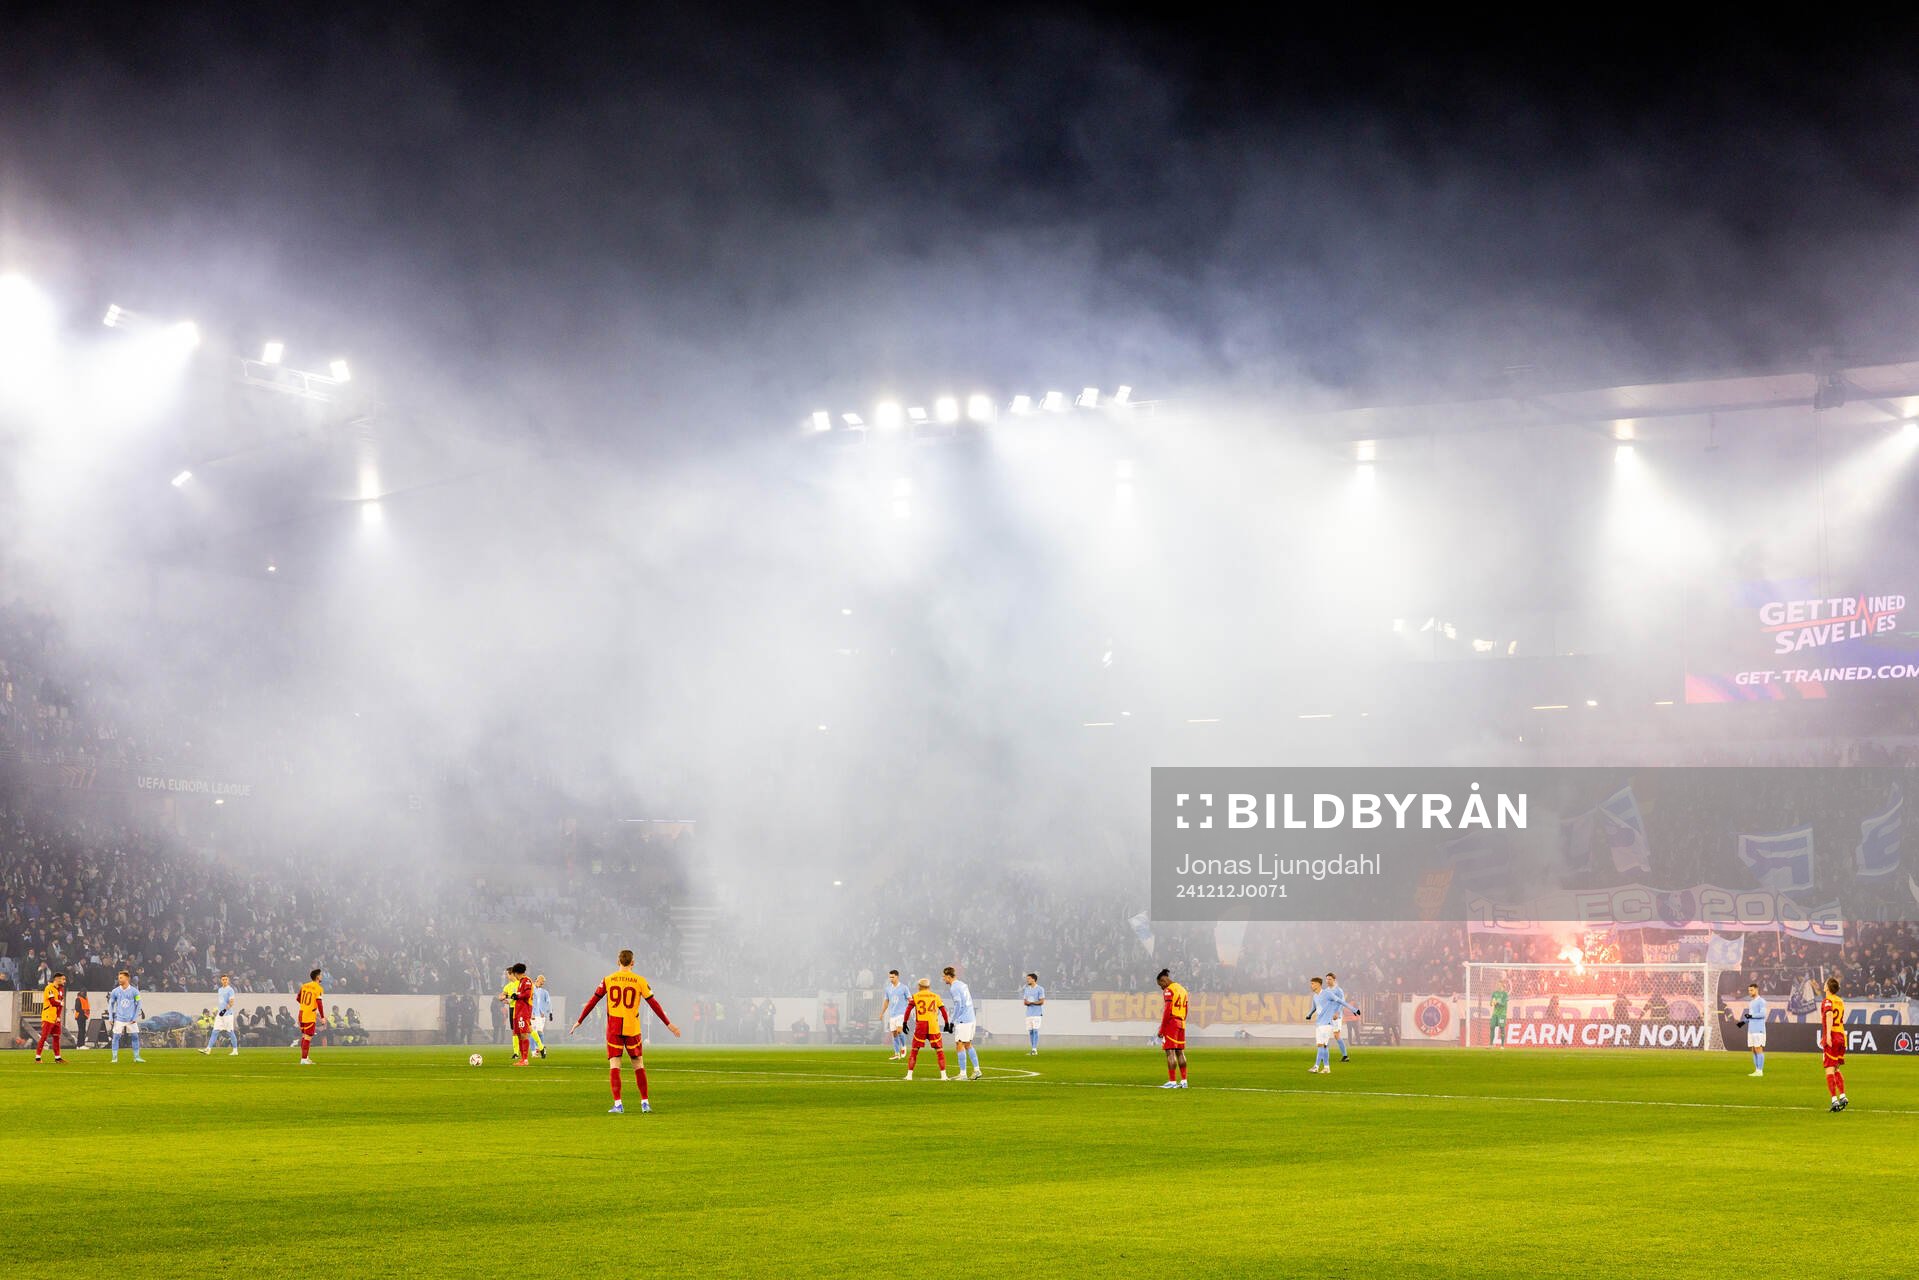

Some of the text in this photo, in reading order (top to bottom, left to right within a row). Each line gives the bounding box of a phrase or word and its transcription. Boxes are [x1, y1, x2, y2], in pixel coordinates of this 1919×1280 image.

[1759, 599, 1823, 626] GET
[1774, 621, 1846, 655] SAVE
[1735, 664, 1919, 686] GET-TRAINED.COM
[137, 775, 166, 790] UEFA
[168, 778, 209, 793] EUROPA
[1700, 888, 1843, 937] 2003
[302, 990, 312, 1006] 10
[609, 985, 637, 1009] 90
[917, 999, 937, 1016] 34
[1092, 988, 1314, 1022] TERR SCANI
[1174, 994, 1188, 1011] 44
[1493, 1023, 1575, 1046] LEARN
[1581, 1023, 1632, 1046] CPR
[1816, 1030, 1877, 1051] FA
